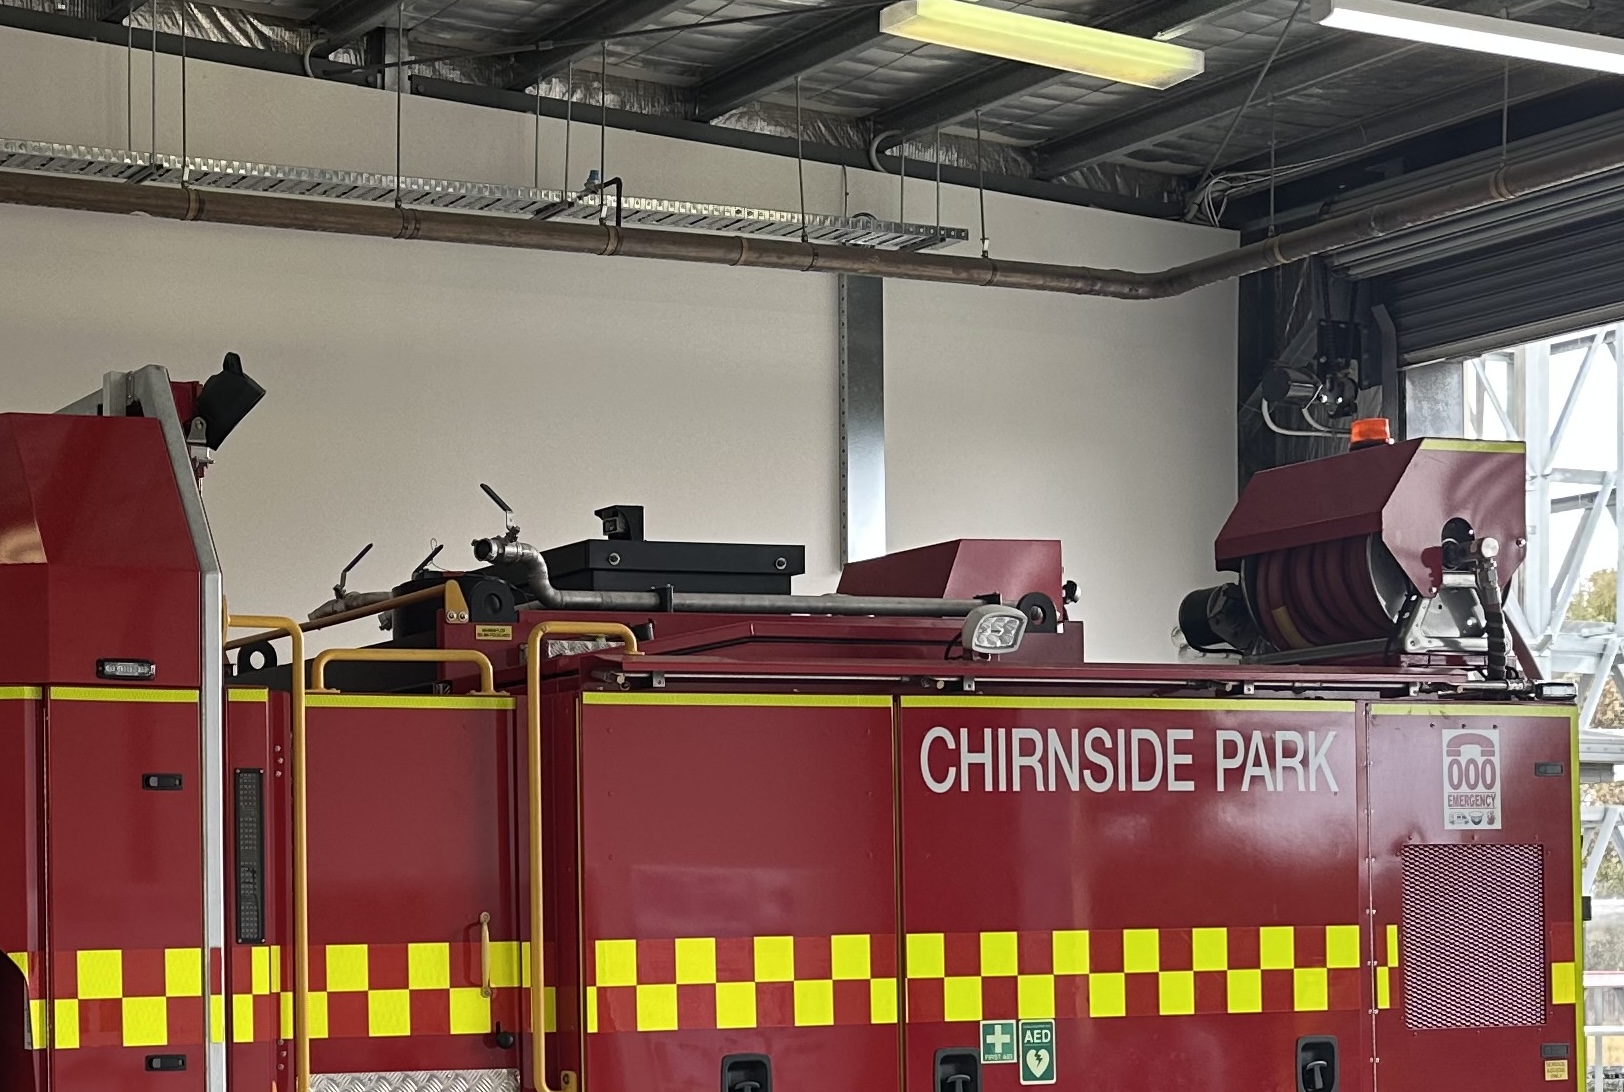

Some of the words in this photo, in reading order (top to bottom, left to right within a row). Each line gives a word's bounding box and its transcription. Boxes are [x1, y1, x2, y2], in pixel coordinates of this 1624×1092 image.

[920, 726, 1195, 793] CHIRNSIDE
[1216, 729, 1339, 792] PARK
[1447, 757, 1497, 791] 000
[1447, 794, 1497, 808] EMERGENCY
[1024, 1029, 1051, 1043] AED
